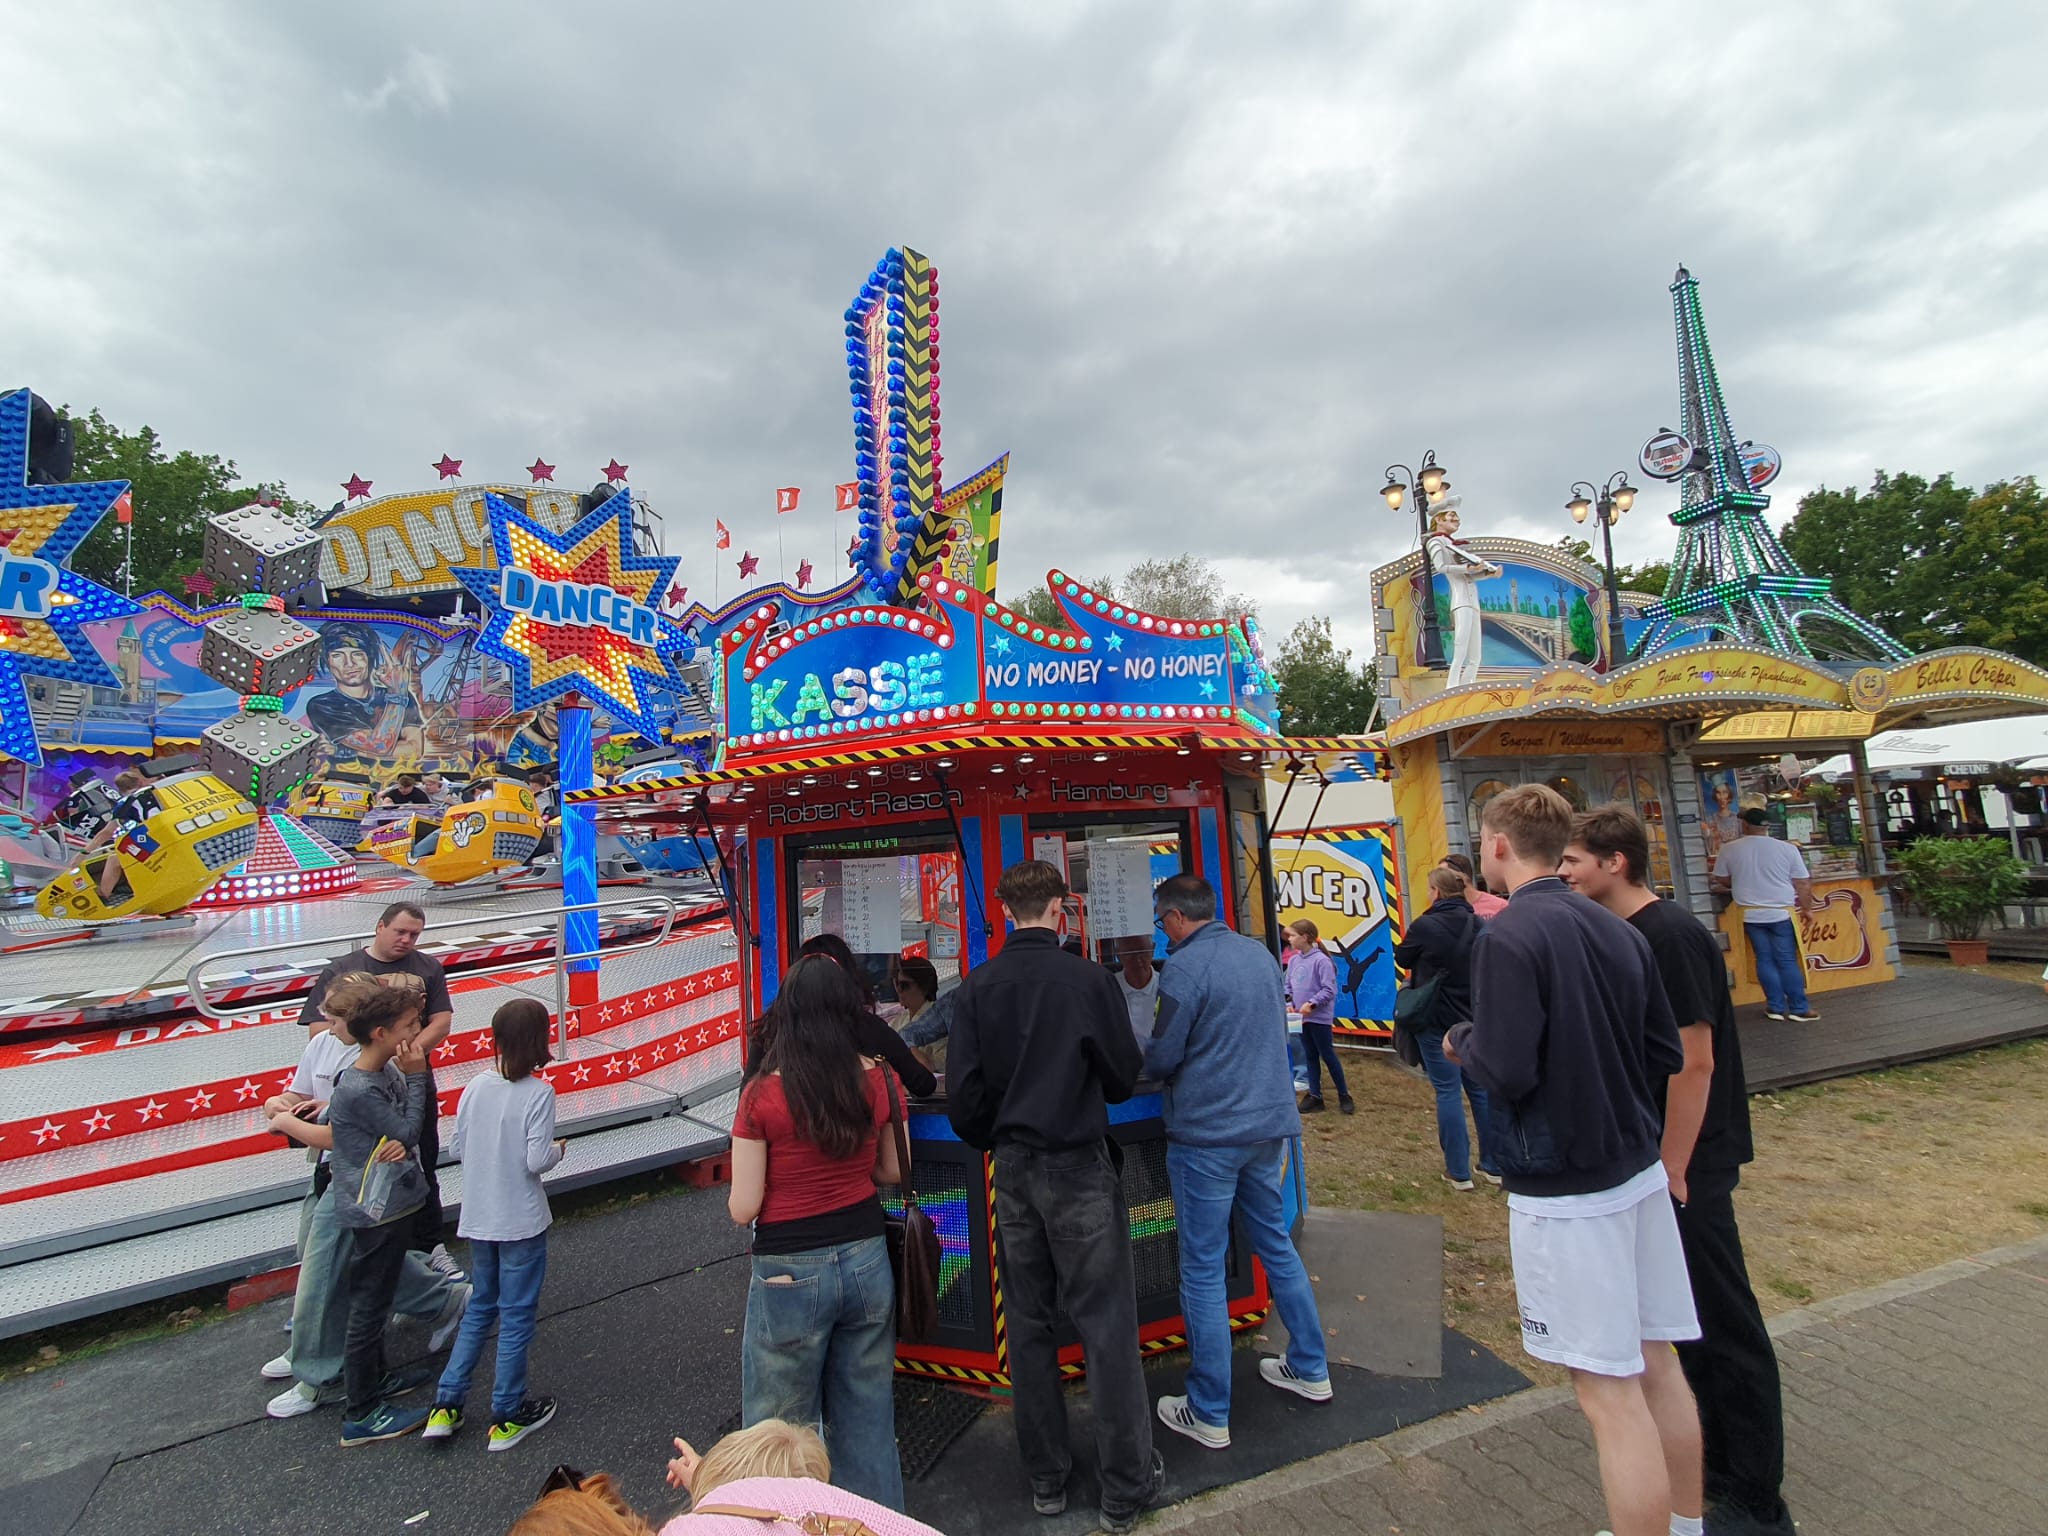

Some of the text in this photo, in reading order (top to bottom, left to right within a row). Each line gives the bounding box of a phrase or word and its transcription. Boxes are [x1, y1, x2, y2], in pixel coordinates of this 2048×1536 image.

[1652, 453, 1684, 468] nutella
[319, 486, 579, 591] DANCR
[504, 572, 657, 645] DANCER
[985, 663, 1021, 689] NO
[1027, 658, 1103, 688] MONEY
[1124, 656, 1156, 681] NO
[1160, 652, 1227, 679] HONEY
[1968, 657, 2017, 689] Crêpes
[750, 651, 945, 731] KASSE
[1943, 764, 1990, 776] SCHEUNE
[1051, 780, 1170, 804] Hamburg
[768, 799, 865, 826] Robert
[1275, 865, 1369, 917] NCER
